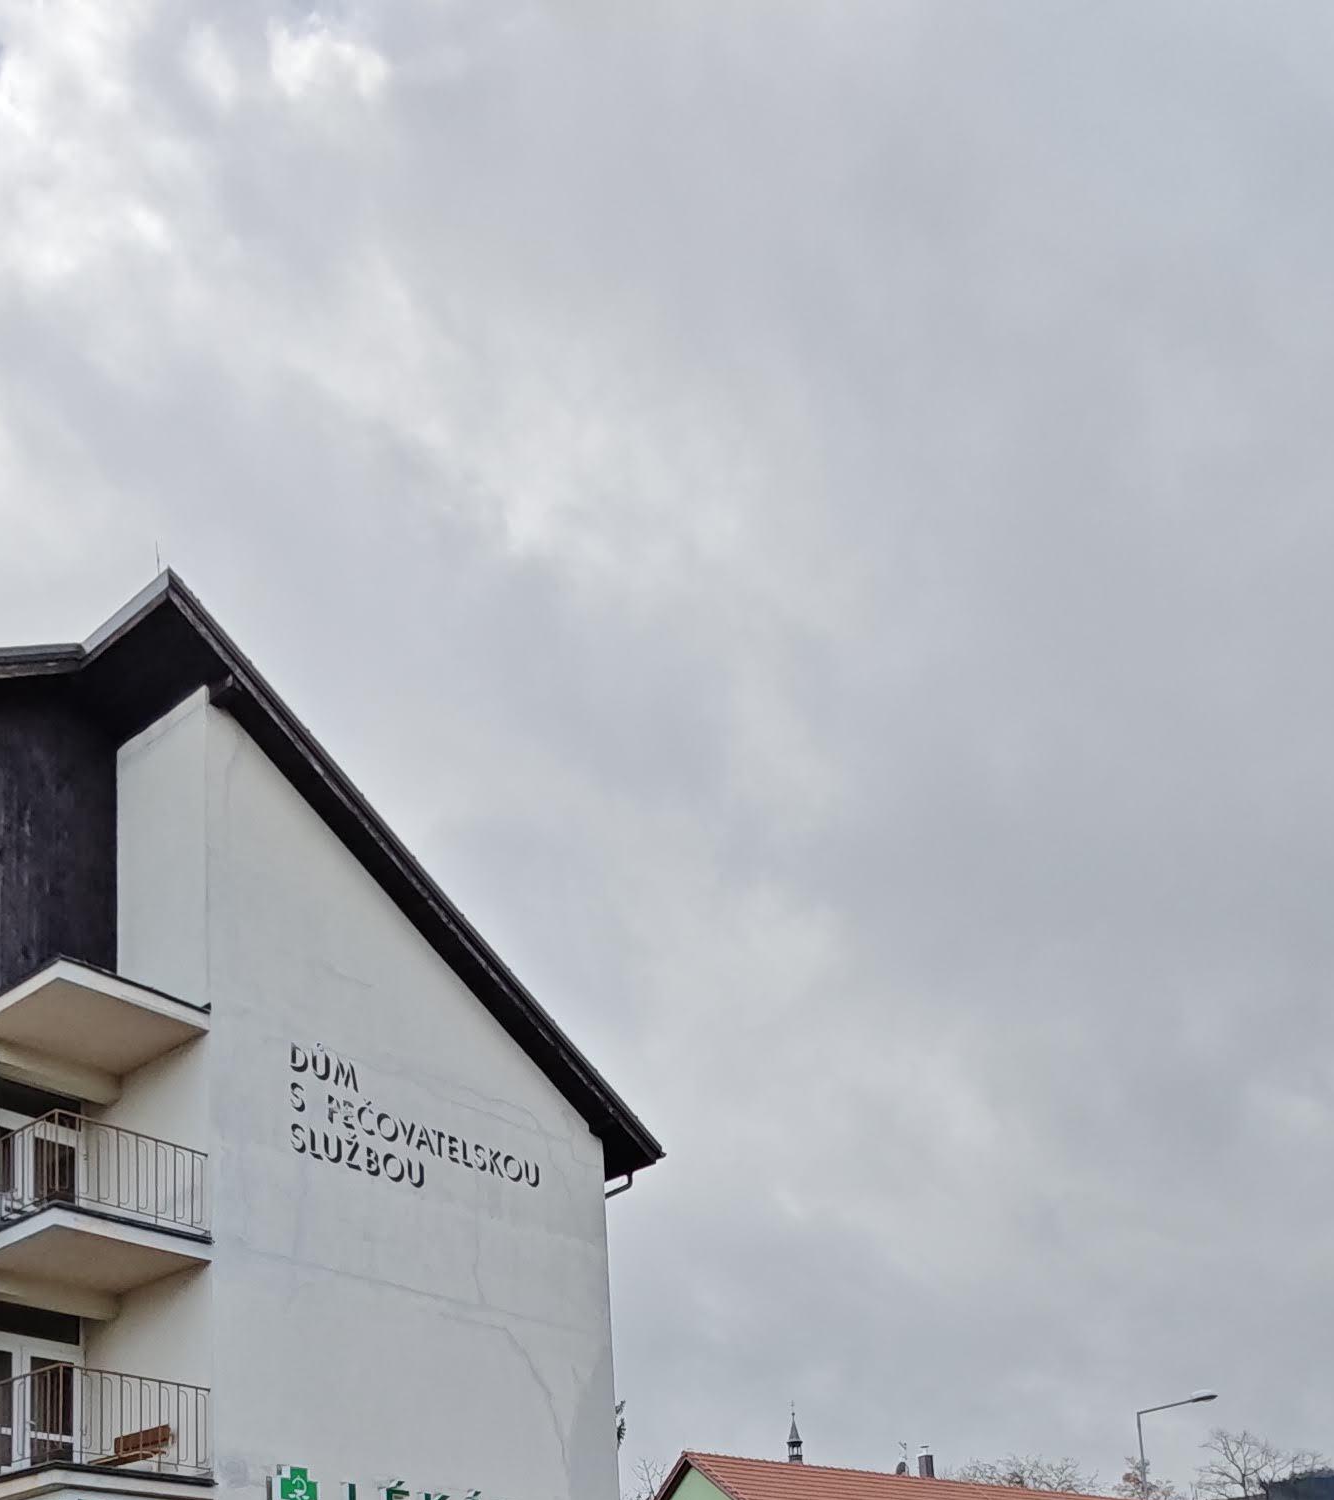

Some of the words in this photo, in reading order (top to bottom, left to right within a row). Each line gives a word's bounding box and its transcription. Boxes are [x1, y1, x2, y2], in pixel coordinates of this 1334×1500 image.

[291, 1042, 358, 1093] DŮM
[291, 1082, 306, 1112] S
[328, 1094, 540, 1187] PEČOVATELSKOU
[291, 1123, 424, 1188] SLUŽBOU
